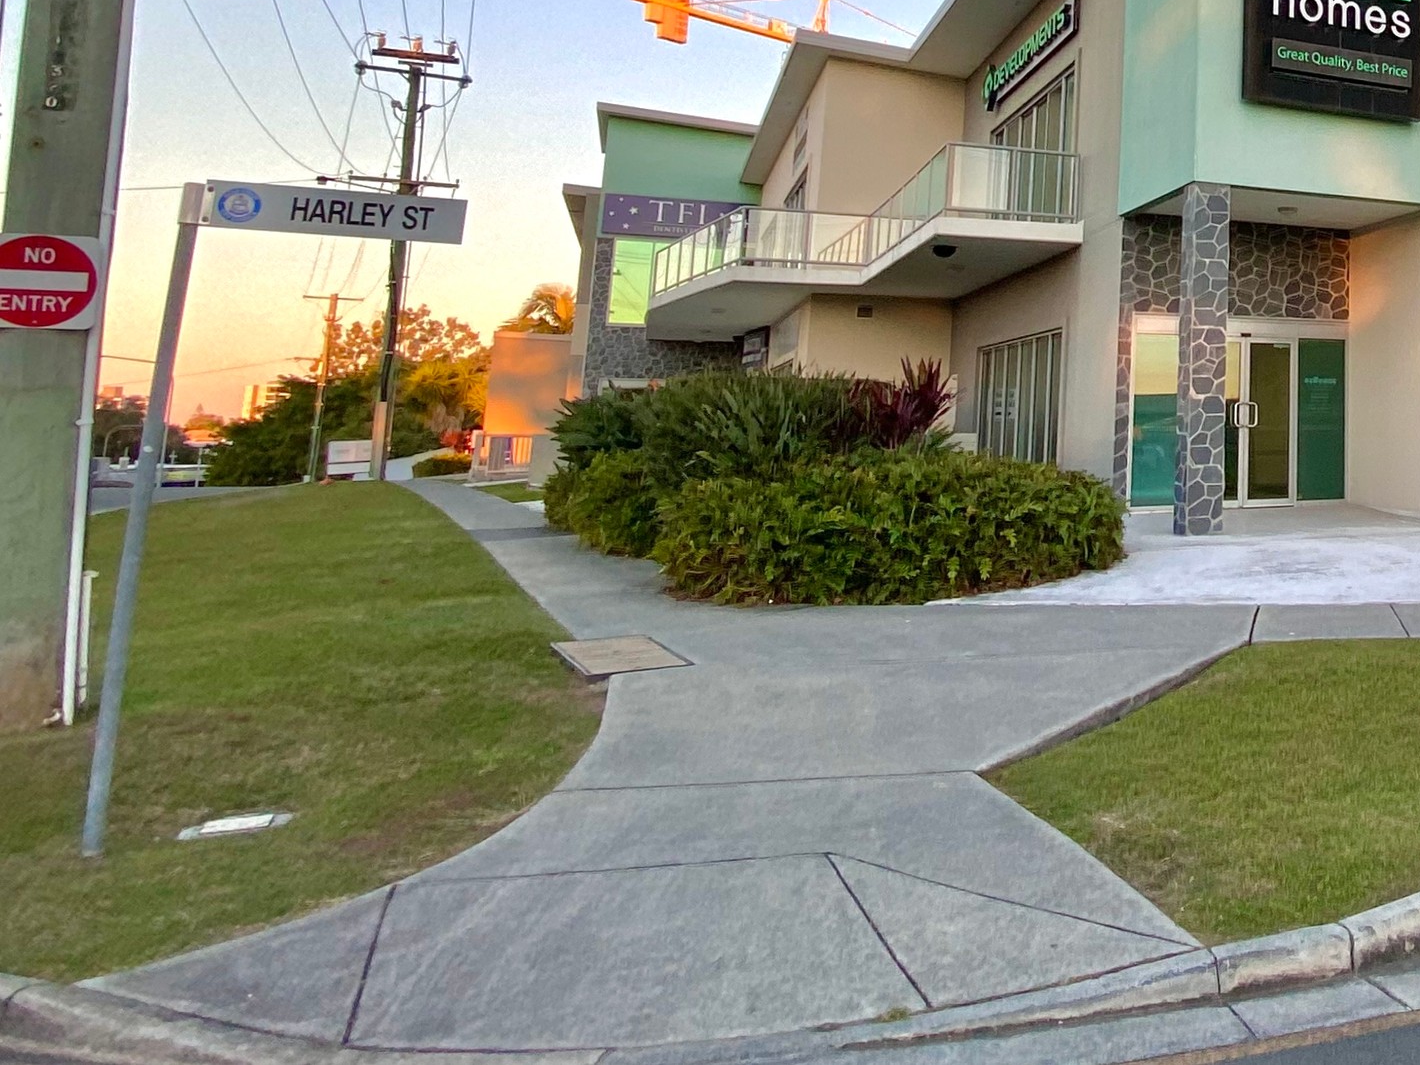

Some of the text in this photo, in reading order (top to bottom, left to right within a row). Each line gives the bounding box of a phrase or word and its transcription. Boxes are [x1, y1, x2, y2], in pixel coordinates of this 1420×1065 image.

[993, 6, 1069, 91] DEVELOPMENTS
[1277, 46, 1409, 78] Great Quality, Best Price
[290, 197, 395, 228] HARLEY
[402, 205, 435, 230] ST
[23, 246, 56, 264] NO
[0, 293, 74, 313] ENTRY
